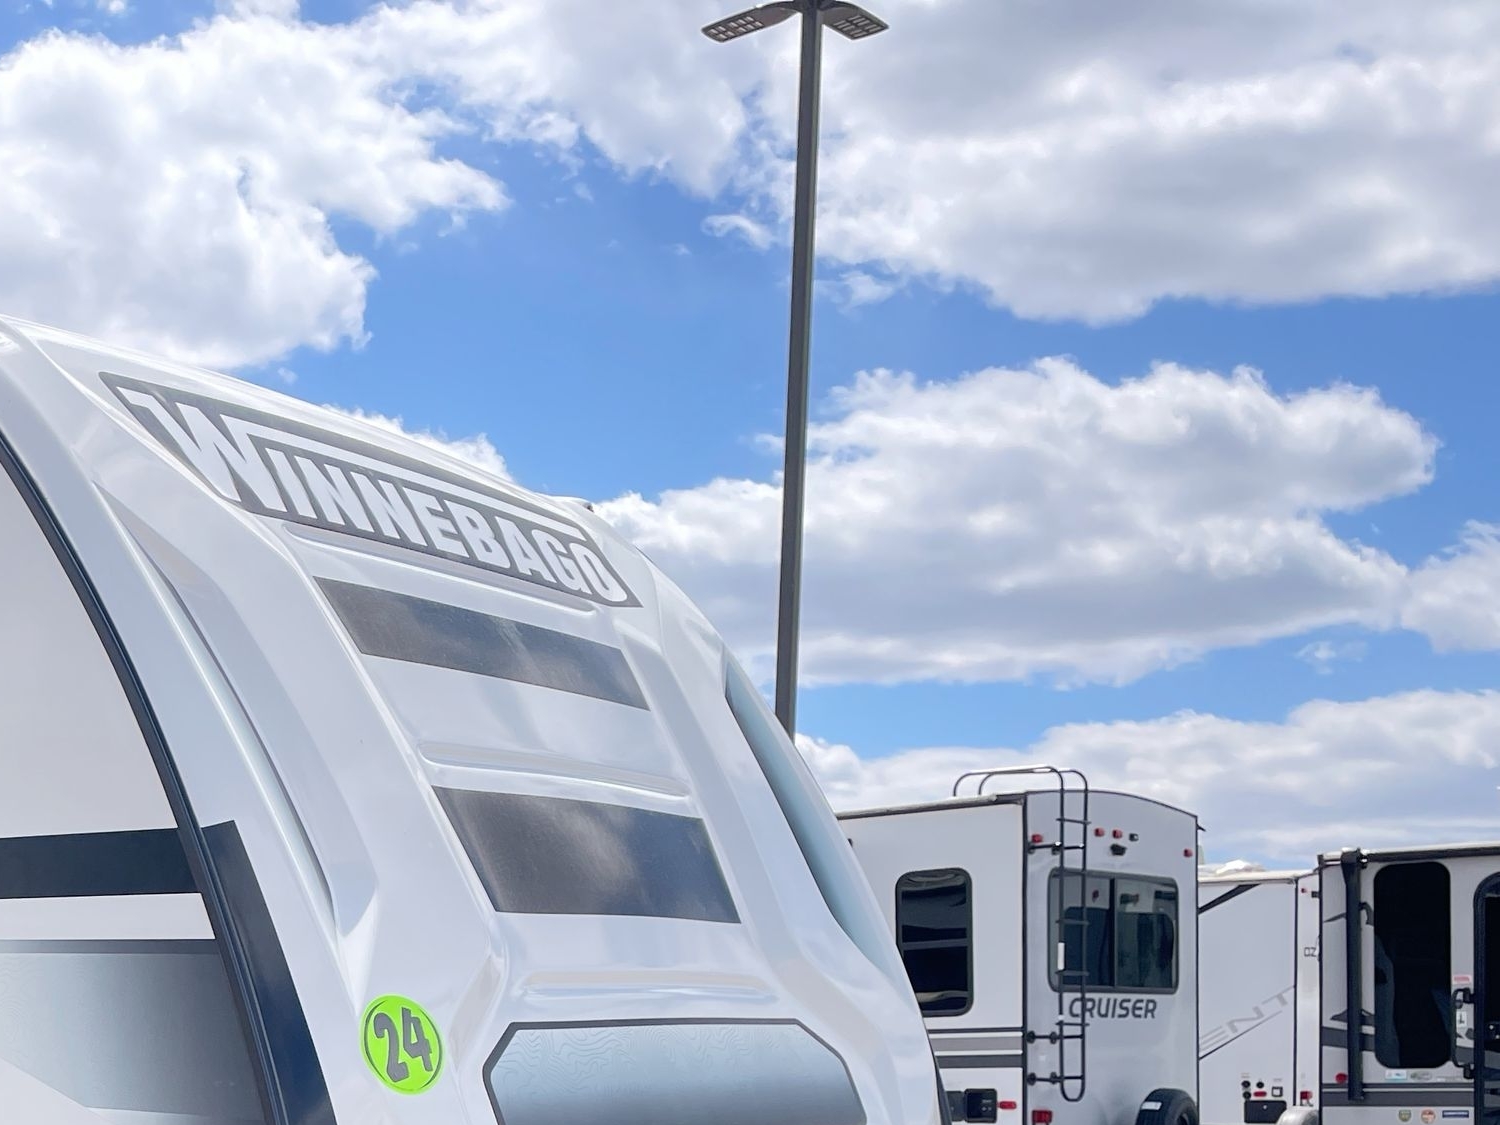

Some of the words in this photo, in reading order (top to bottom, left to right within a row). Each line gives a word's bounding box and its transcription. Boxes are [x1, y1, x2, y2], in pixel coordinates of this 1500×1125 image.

[116, 385, 628, 602] WINNEBAGO
[373, 1006, 433, 1083] 24
[1069, 997, 1157, 1019] CRUISER
